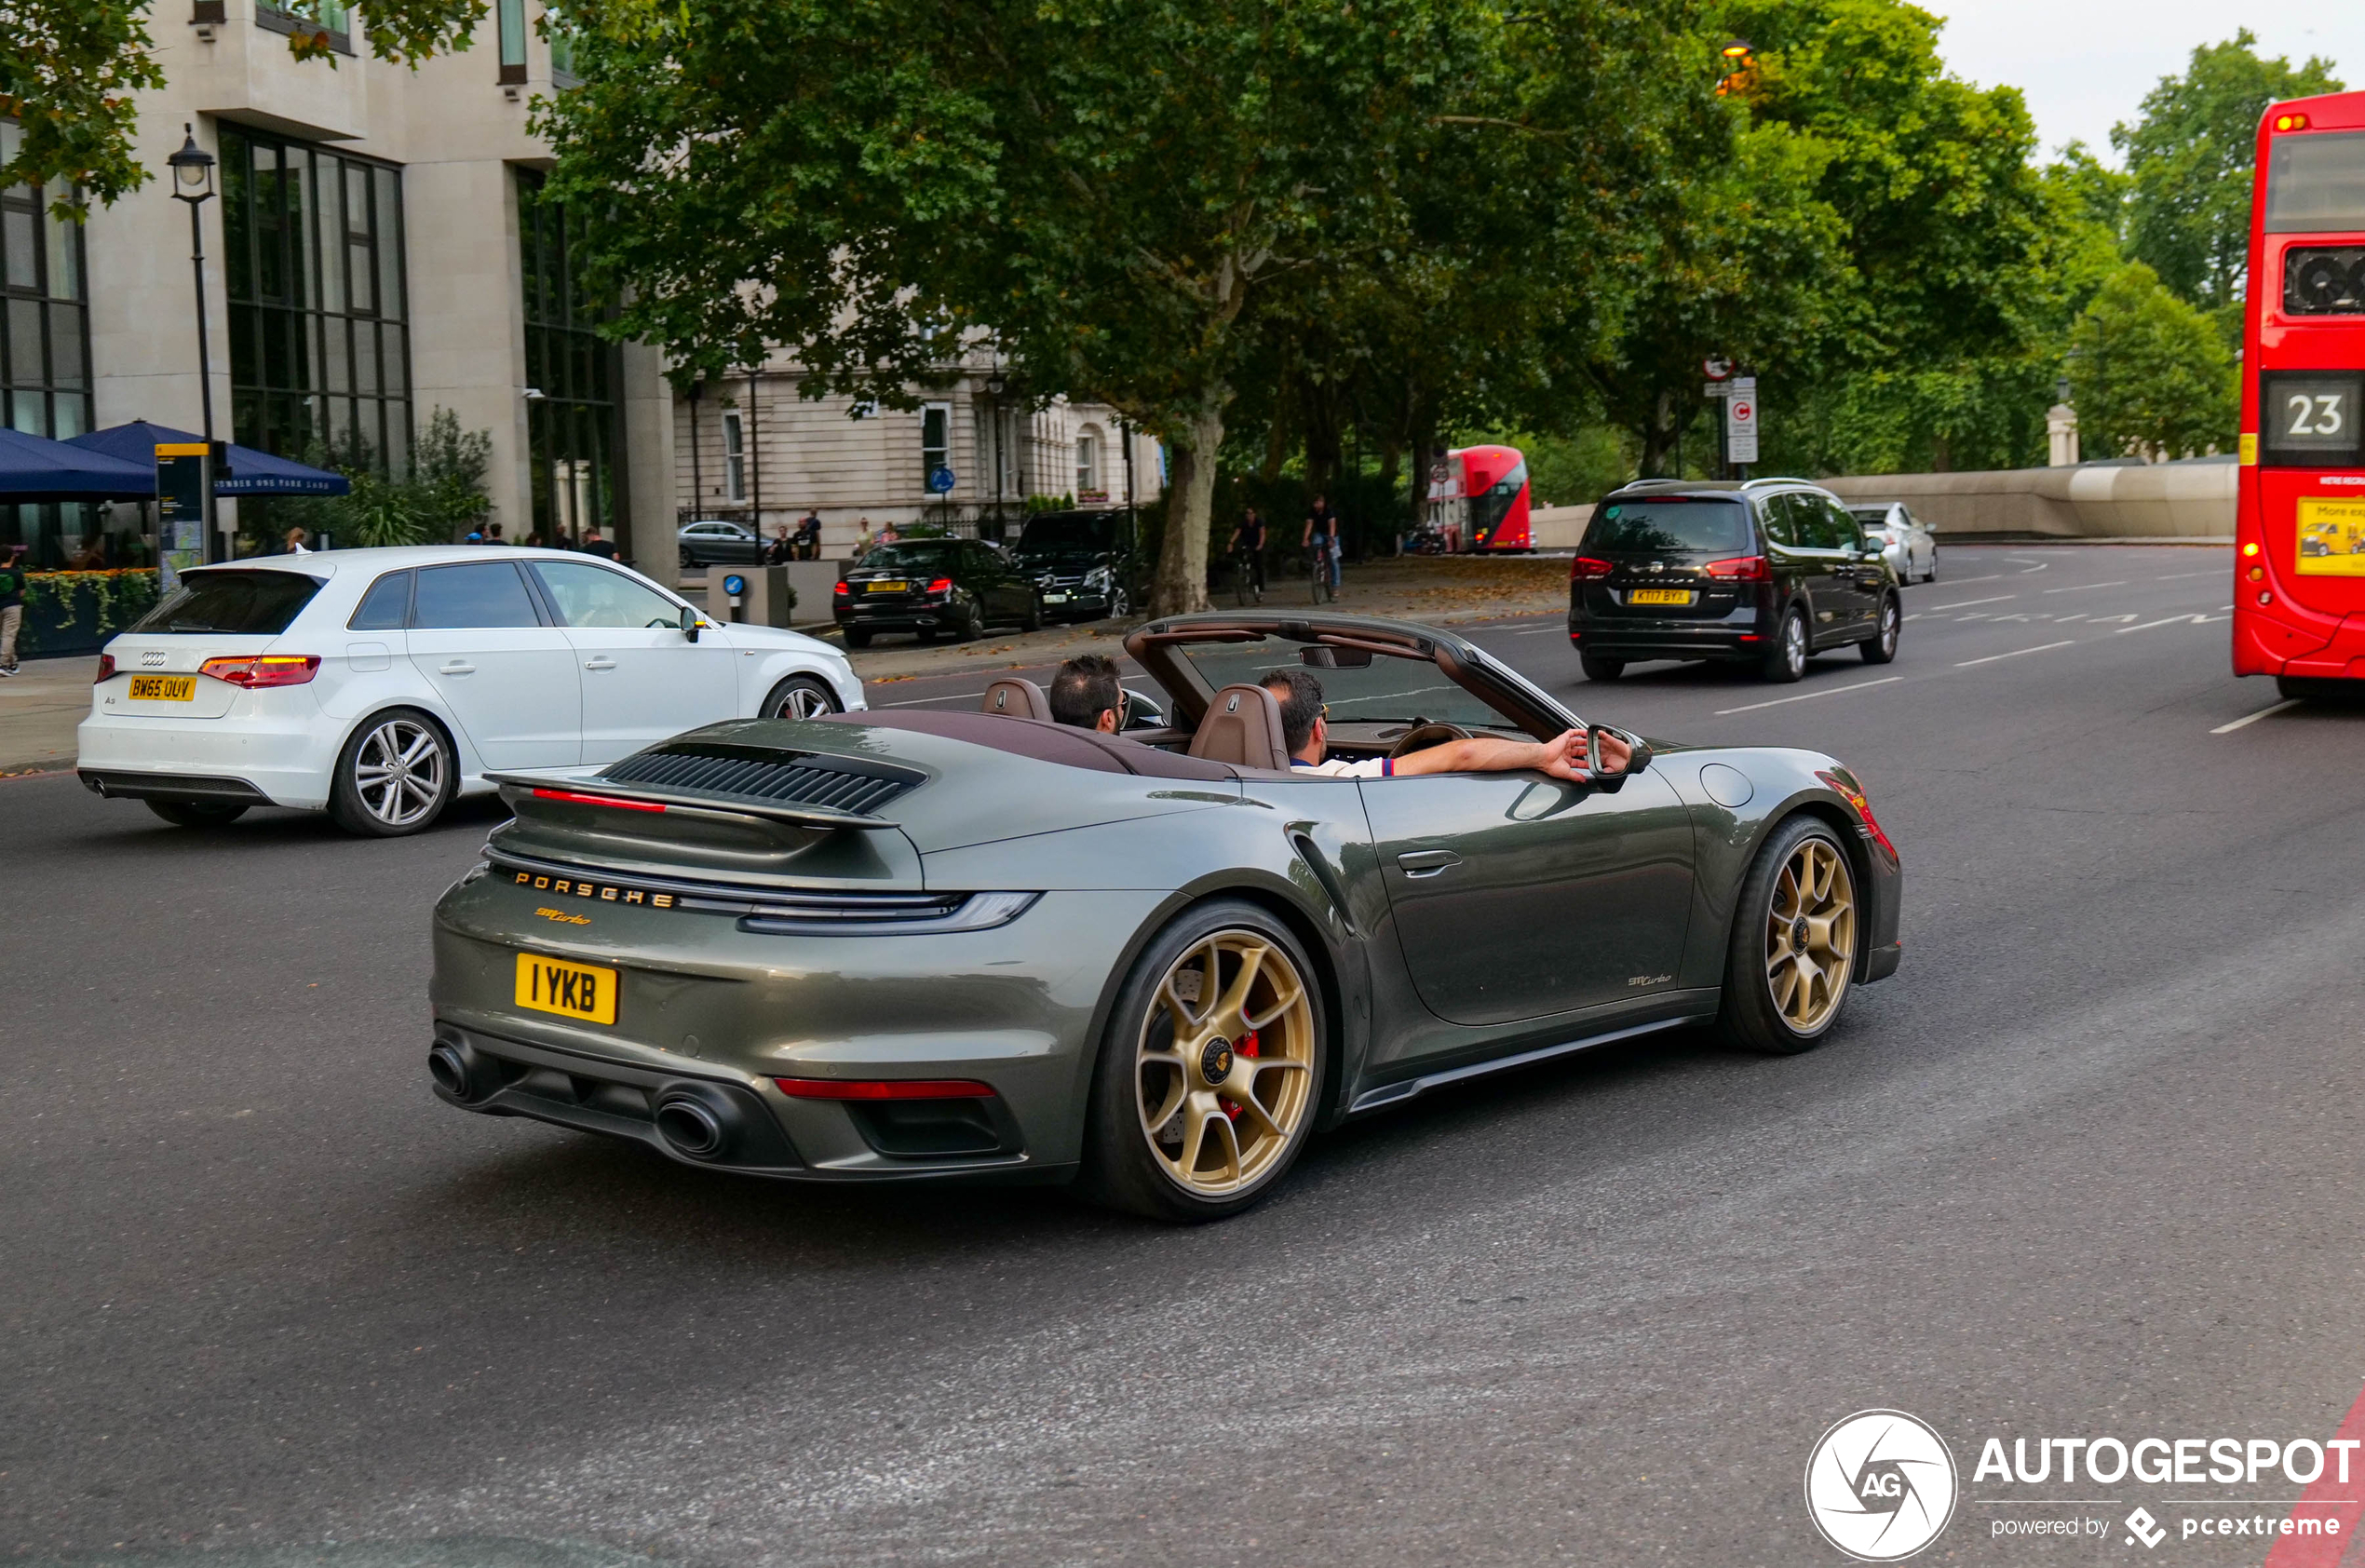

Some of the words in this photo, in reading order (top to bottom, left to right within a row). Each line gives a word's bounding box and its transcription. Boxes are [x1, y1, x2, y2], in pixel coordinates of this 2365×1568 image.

[2288, 395, 2343, 435] 23
[278, 479, 302, 488] PARK
[2317, 507, 2346, 516] More
[1638, 590, 1661, 602] KT17
[132, 680, 163, 696] BW65
[165, 681, 190, 697] OUV
[515, 872, 673, 908] PORSCHE
[546, 966, 596, 1013] YKB
